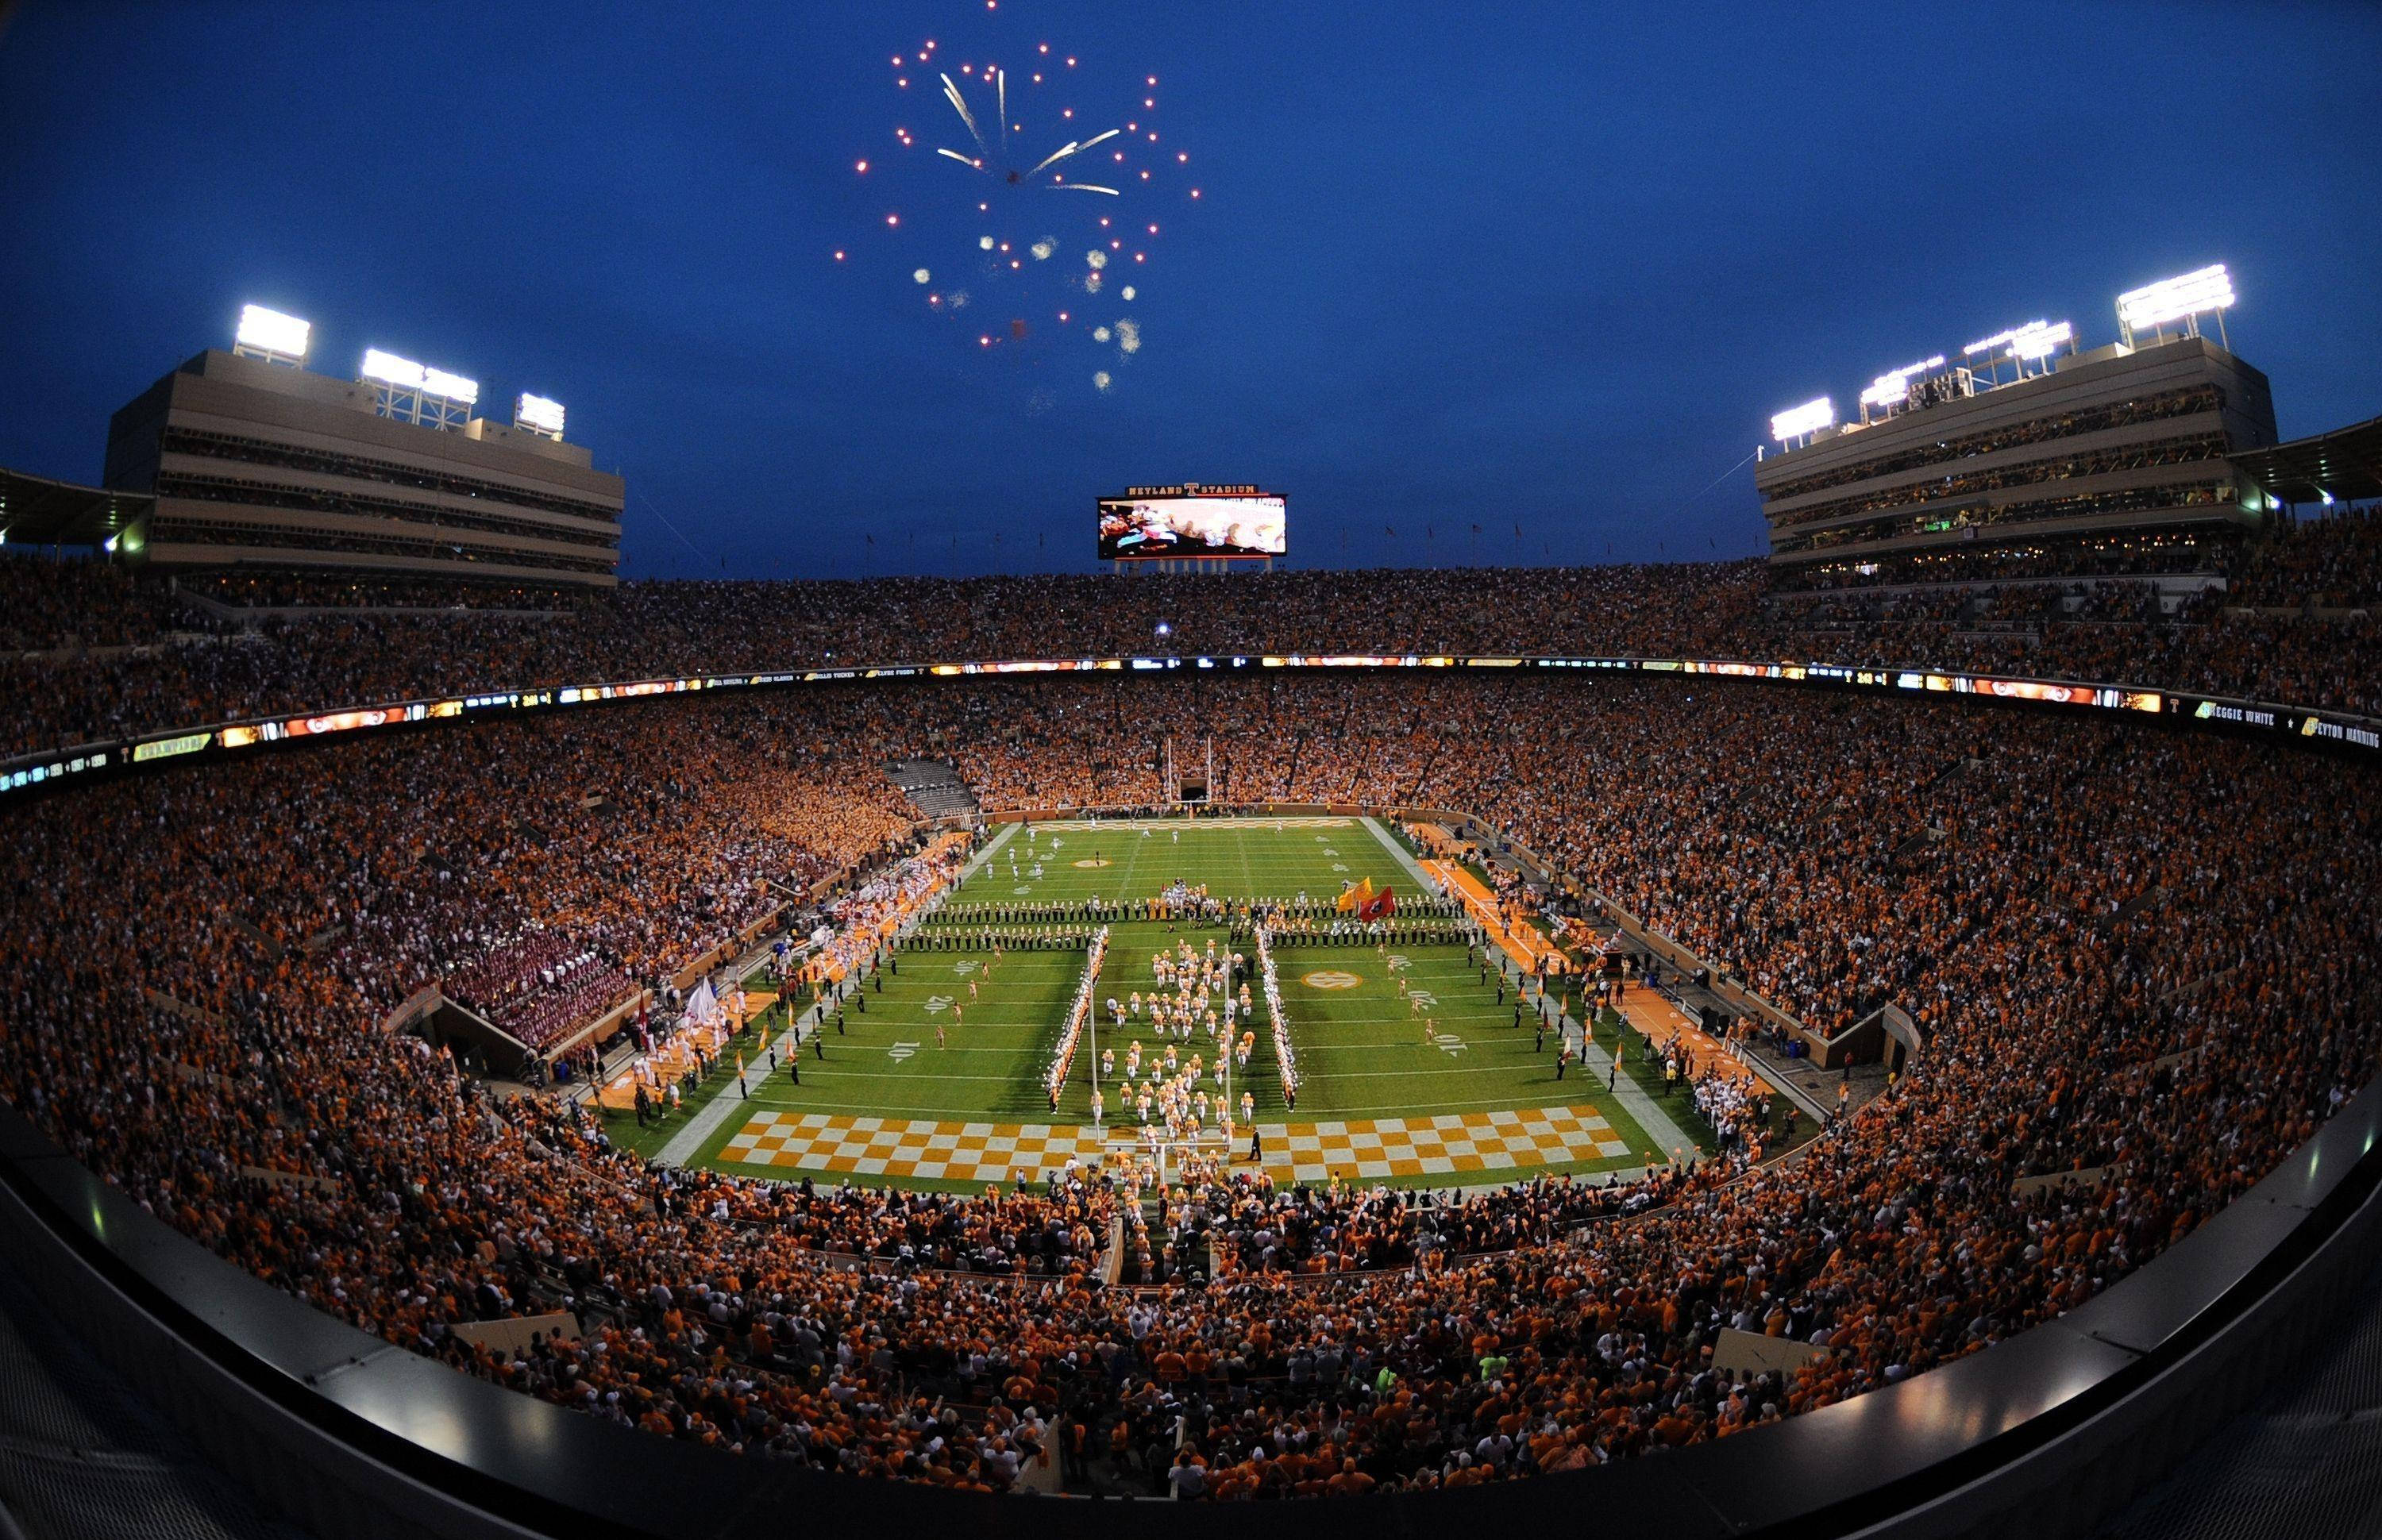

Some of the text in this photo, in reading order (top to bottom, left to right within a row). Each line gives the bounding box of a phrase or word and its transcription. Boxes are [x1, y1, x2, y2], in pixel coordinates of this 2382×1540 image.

[1129, 486, 1182, 495] NEYLAND
[1201, 485, 1255, 494] STADIUM
[2209, 705, 2242, 721] REGGIE
[2245, 710, 2275, 726] WHITE
[2346, 727, 2380, 749] MANNING
[924, 995, 954, 1011] 20
[888, 1041, 921, 1058] 10
[1433, 1034, 1468, 1052] 10
